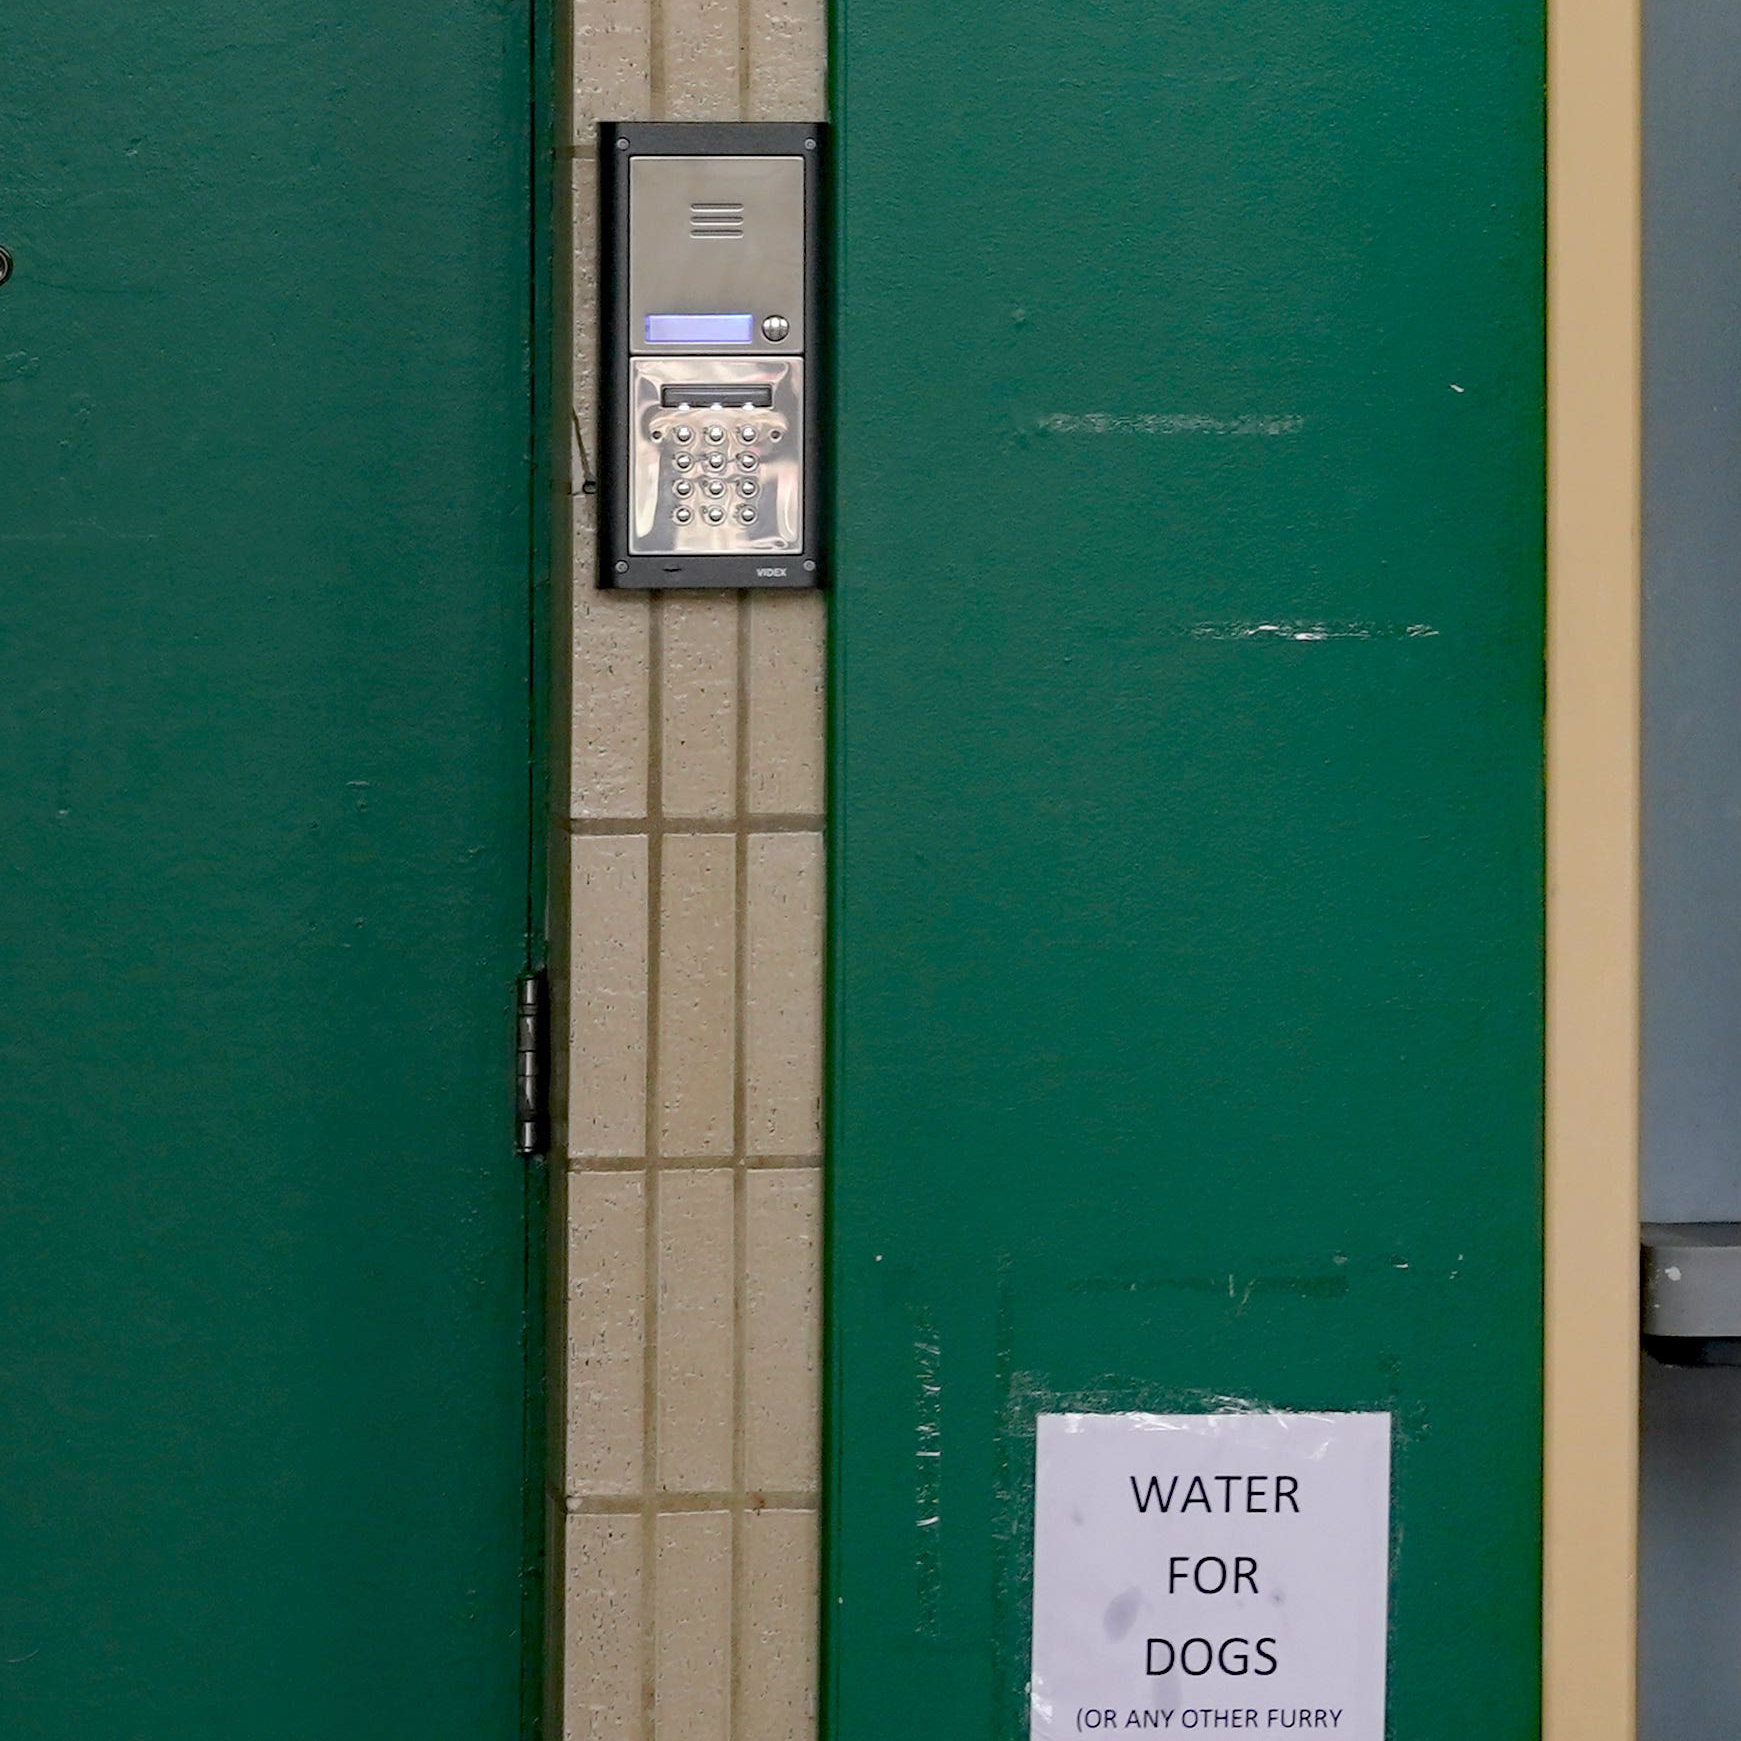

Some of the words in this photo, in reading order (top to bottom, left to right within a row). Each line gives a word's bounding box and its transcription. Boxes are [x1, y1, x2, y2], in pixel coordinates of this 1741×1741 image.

[756, 568, 787, 578] VIDEX
[1130, 1476, 1299, 1513] WATER
[1170, 1557, 1258, 1594] FOR
[1146, 1638, 1277, 1676] DOGS
[1077, 1708, 1117, 1732] (OR
[1125, 1710, 1174, 1728] ANY
[1182, 1709, 1257, 1728] OTHER
[1268, 1709, 1342, 1728] FURRY
